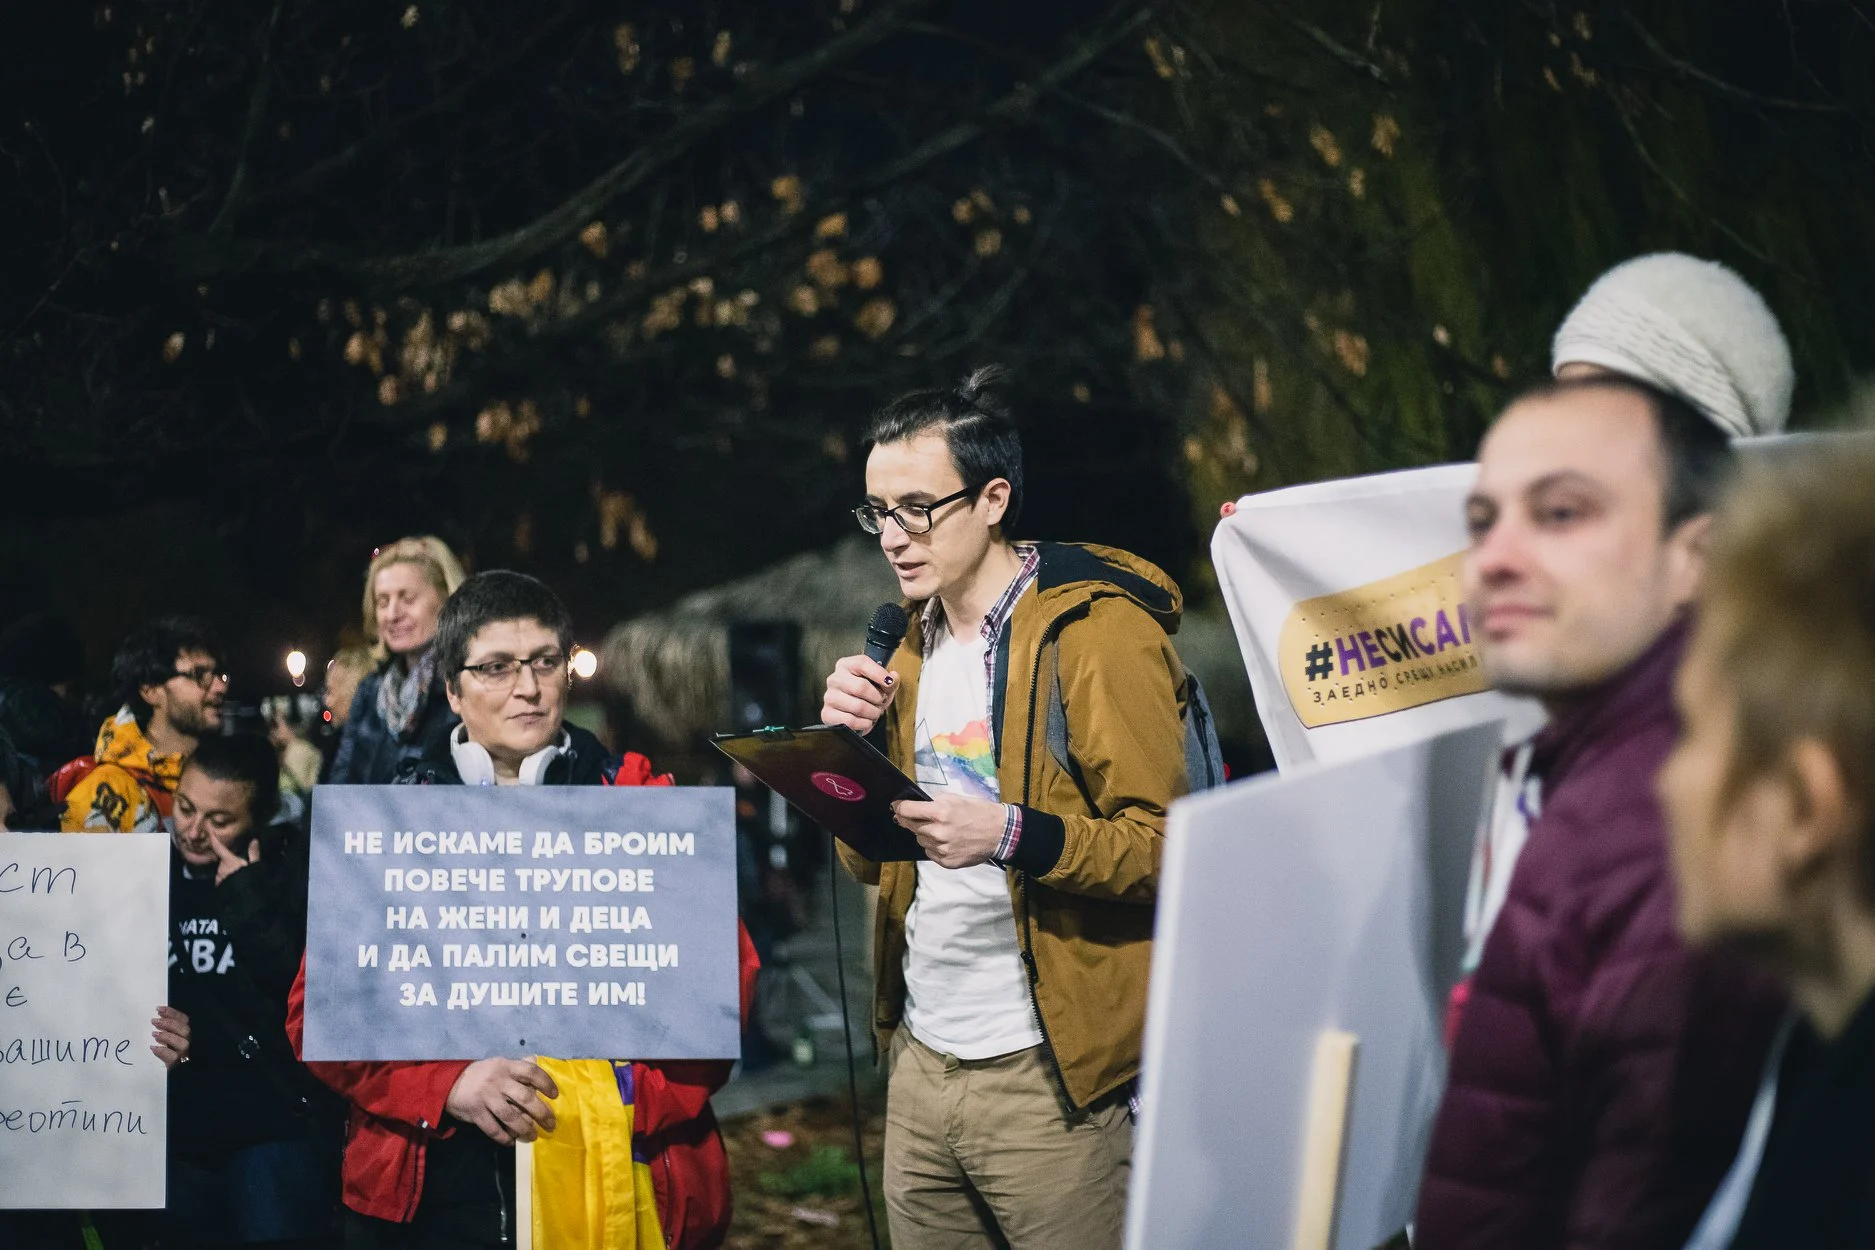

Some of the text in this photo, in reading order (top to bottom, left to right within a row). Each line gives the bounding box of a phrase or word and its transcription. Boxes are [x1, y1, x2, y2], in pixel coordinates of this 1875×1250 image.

[1312, 678, 1389, 704] ЗАЕДНО
[344, 830, 695, 858] НЕ ИСКАМЕ ДА БРОИМ
[384, 868, 655, 892] ПОВЕЧЕ ТРУПОВЕ
[386, 905, 653, 933] НА ЖЕНИ И ДЕЦА
[358, 944, 679, 972] И ДА ПАЛИМ СВЕЩИ
[399, 982, 647, 1010] ЗА ДУШИТЕ ИМ!
[0, 1037, 134, 1066] ашите
